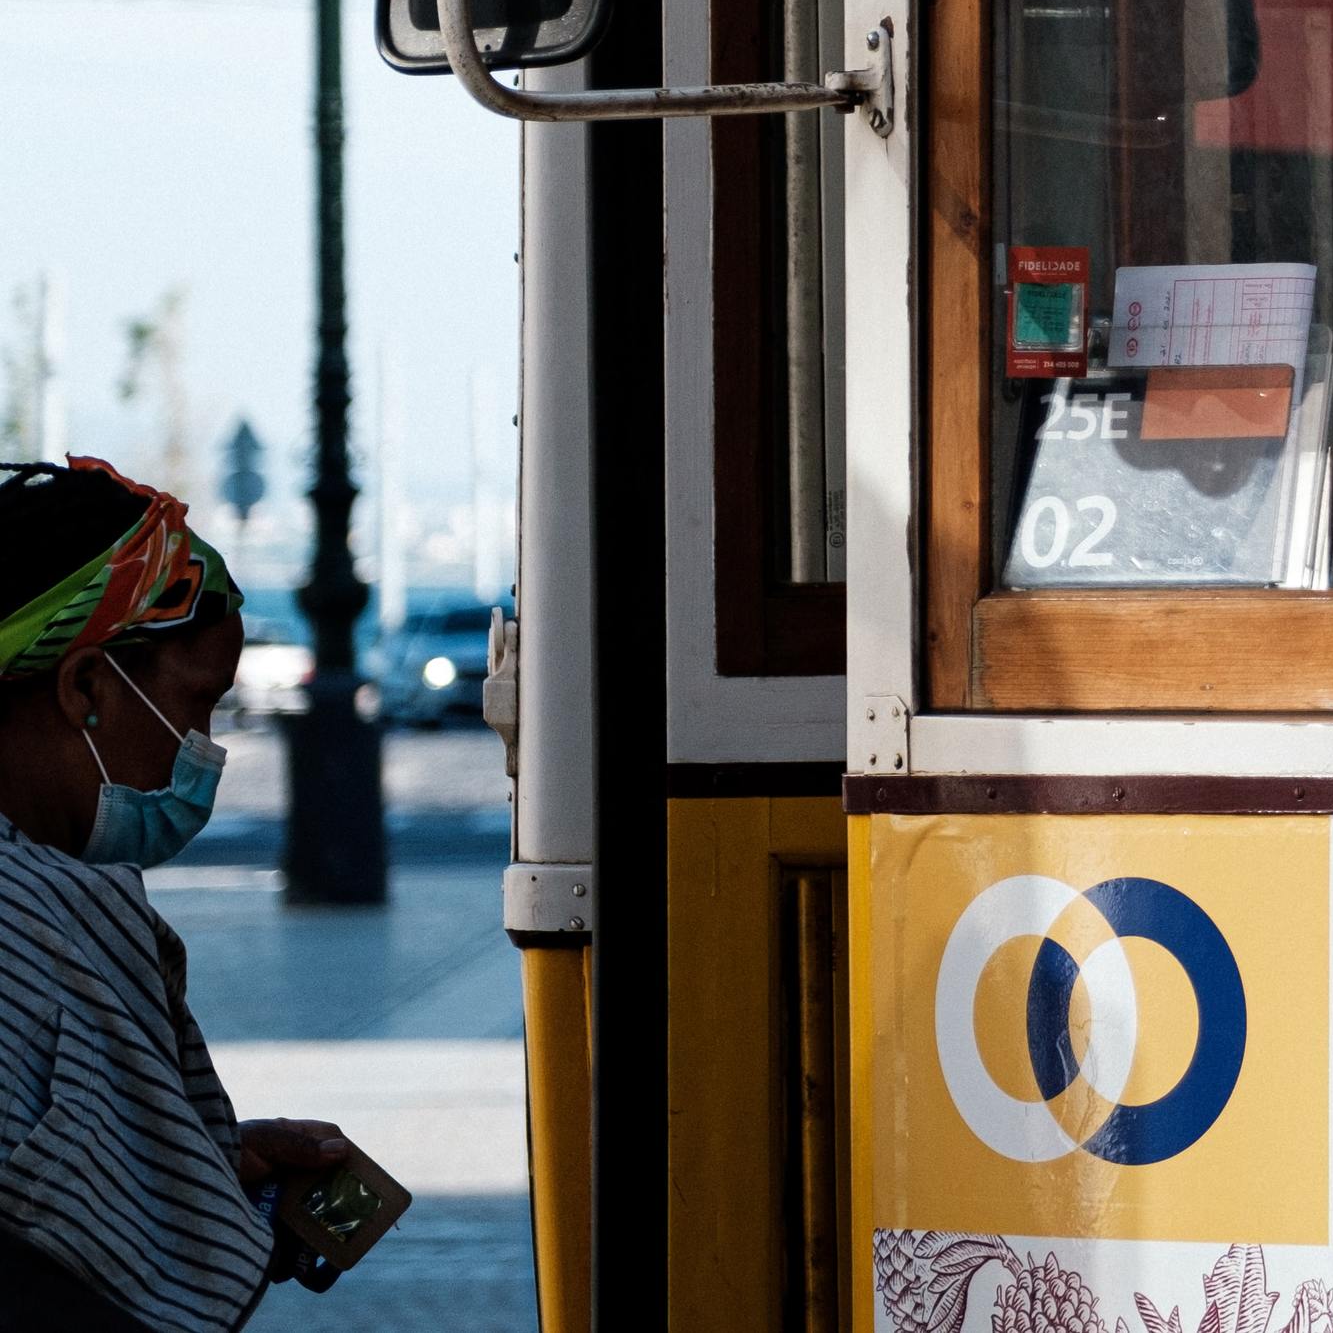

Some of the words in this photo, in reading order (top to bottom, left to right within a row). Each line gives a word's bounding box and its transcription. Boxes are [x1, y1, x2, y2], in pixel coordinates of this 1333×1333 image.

[1017, 261, 1081, 272] FIDELIDADE
[1034, 392, 1132, 441] 25E
[1021, 494, 1118, 568] 02
